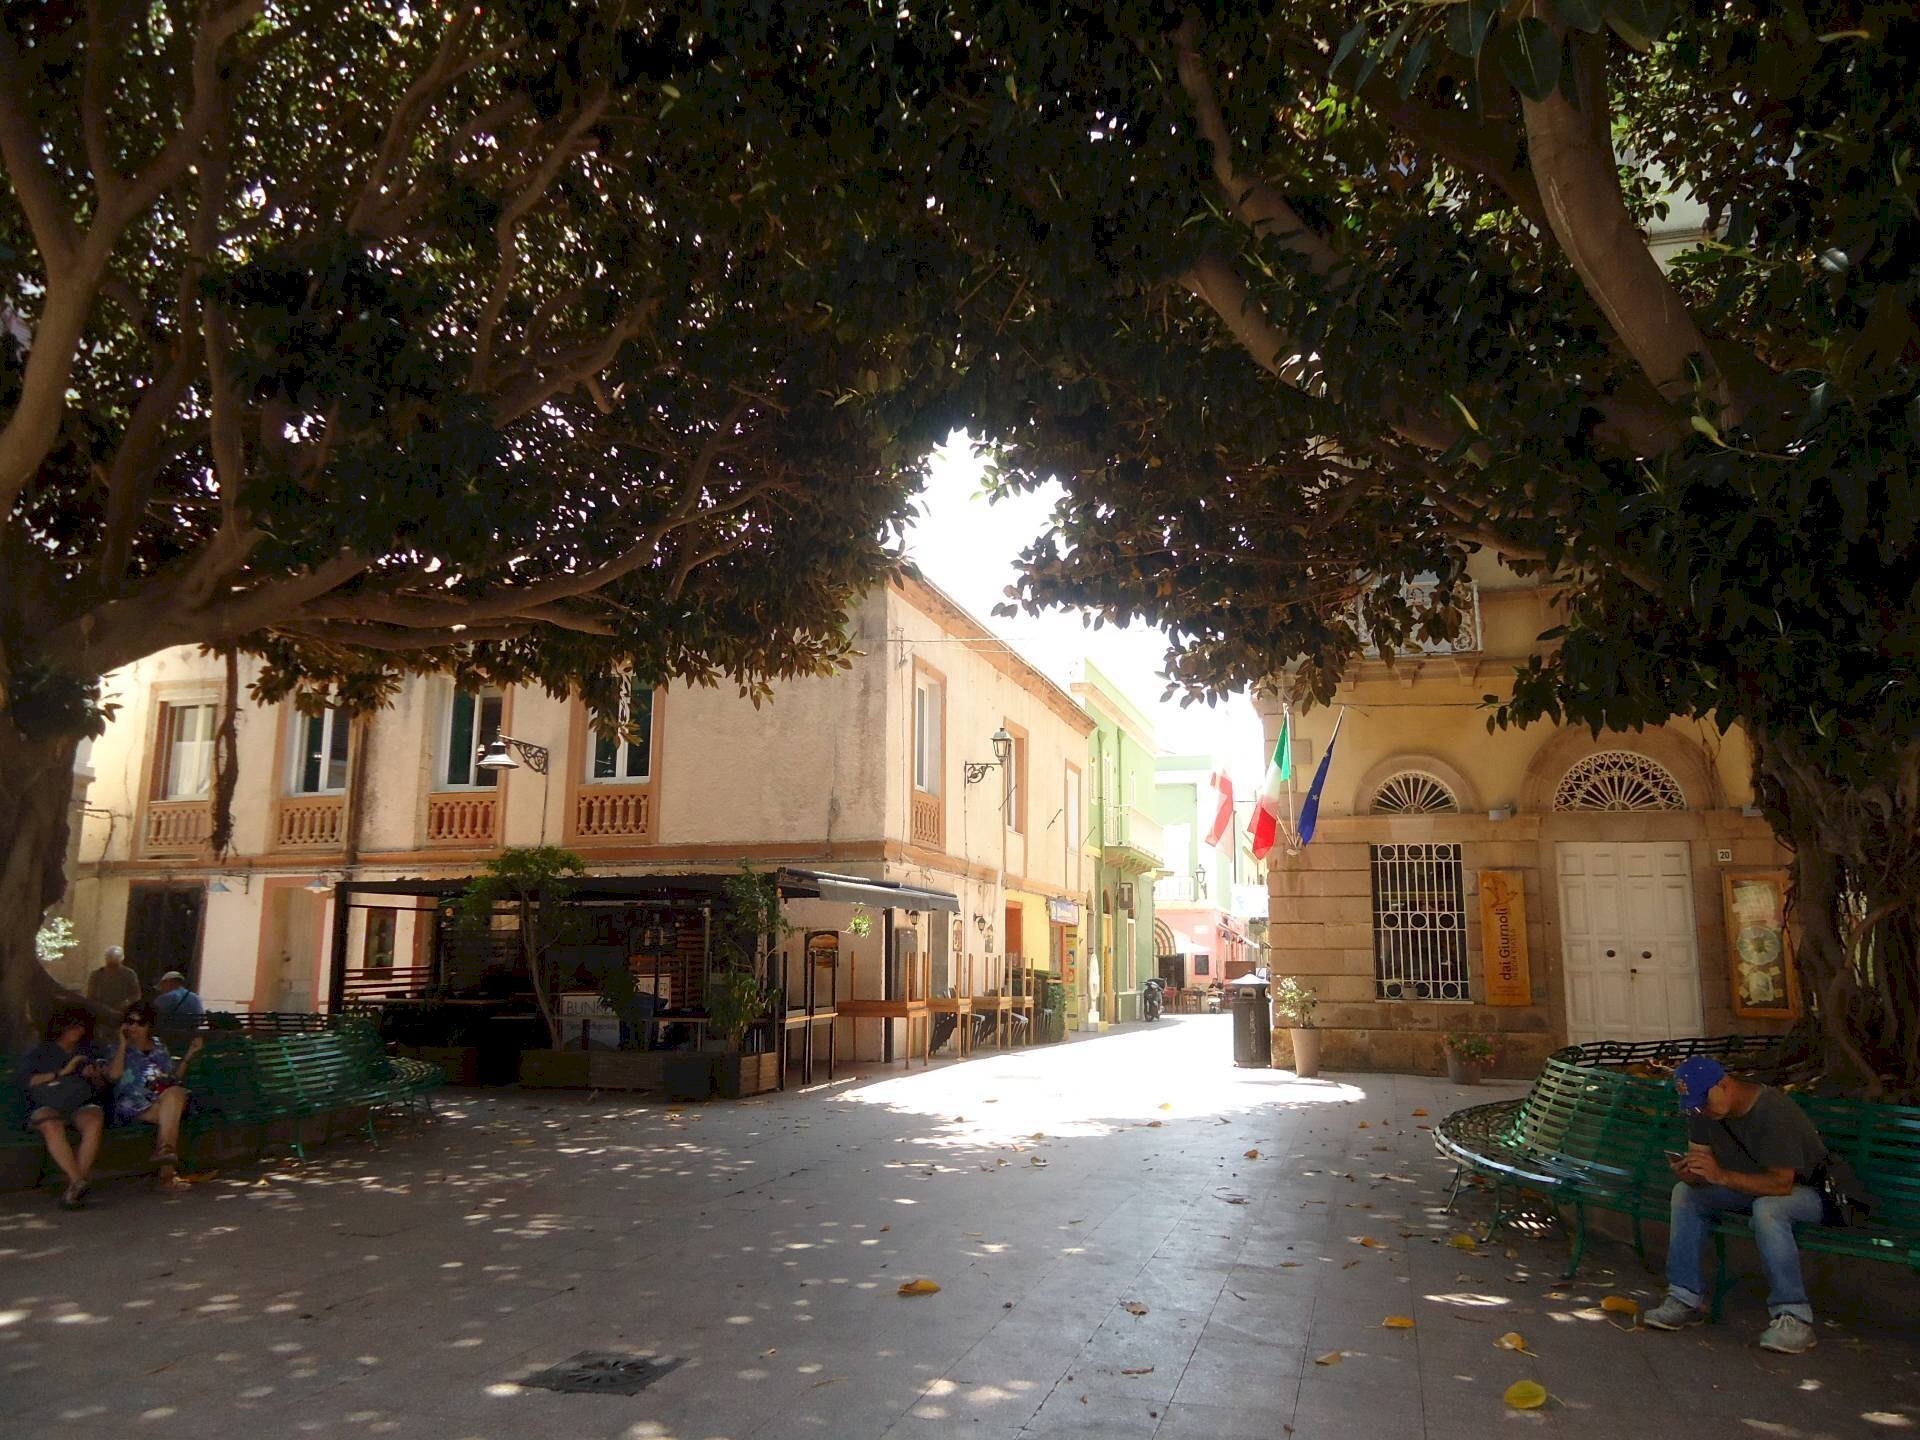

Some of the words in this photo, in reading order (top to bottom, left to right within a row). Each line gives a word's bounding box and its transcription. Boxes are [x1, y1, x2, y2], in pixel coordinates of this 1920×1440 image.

[1719, 851, 1730, 859] 20
[1121, 884, 1131, 902] T
[1496, 907, 1510, 958] Giurnoli
[1499, 961, 1512, 980] dai
